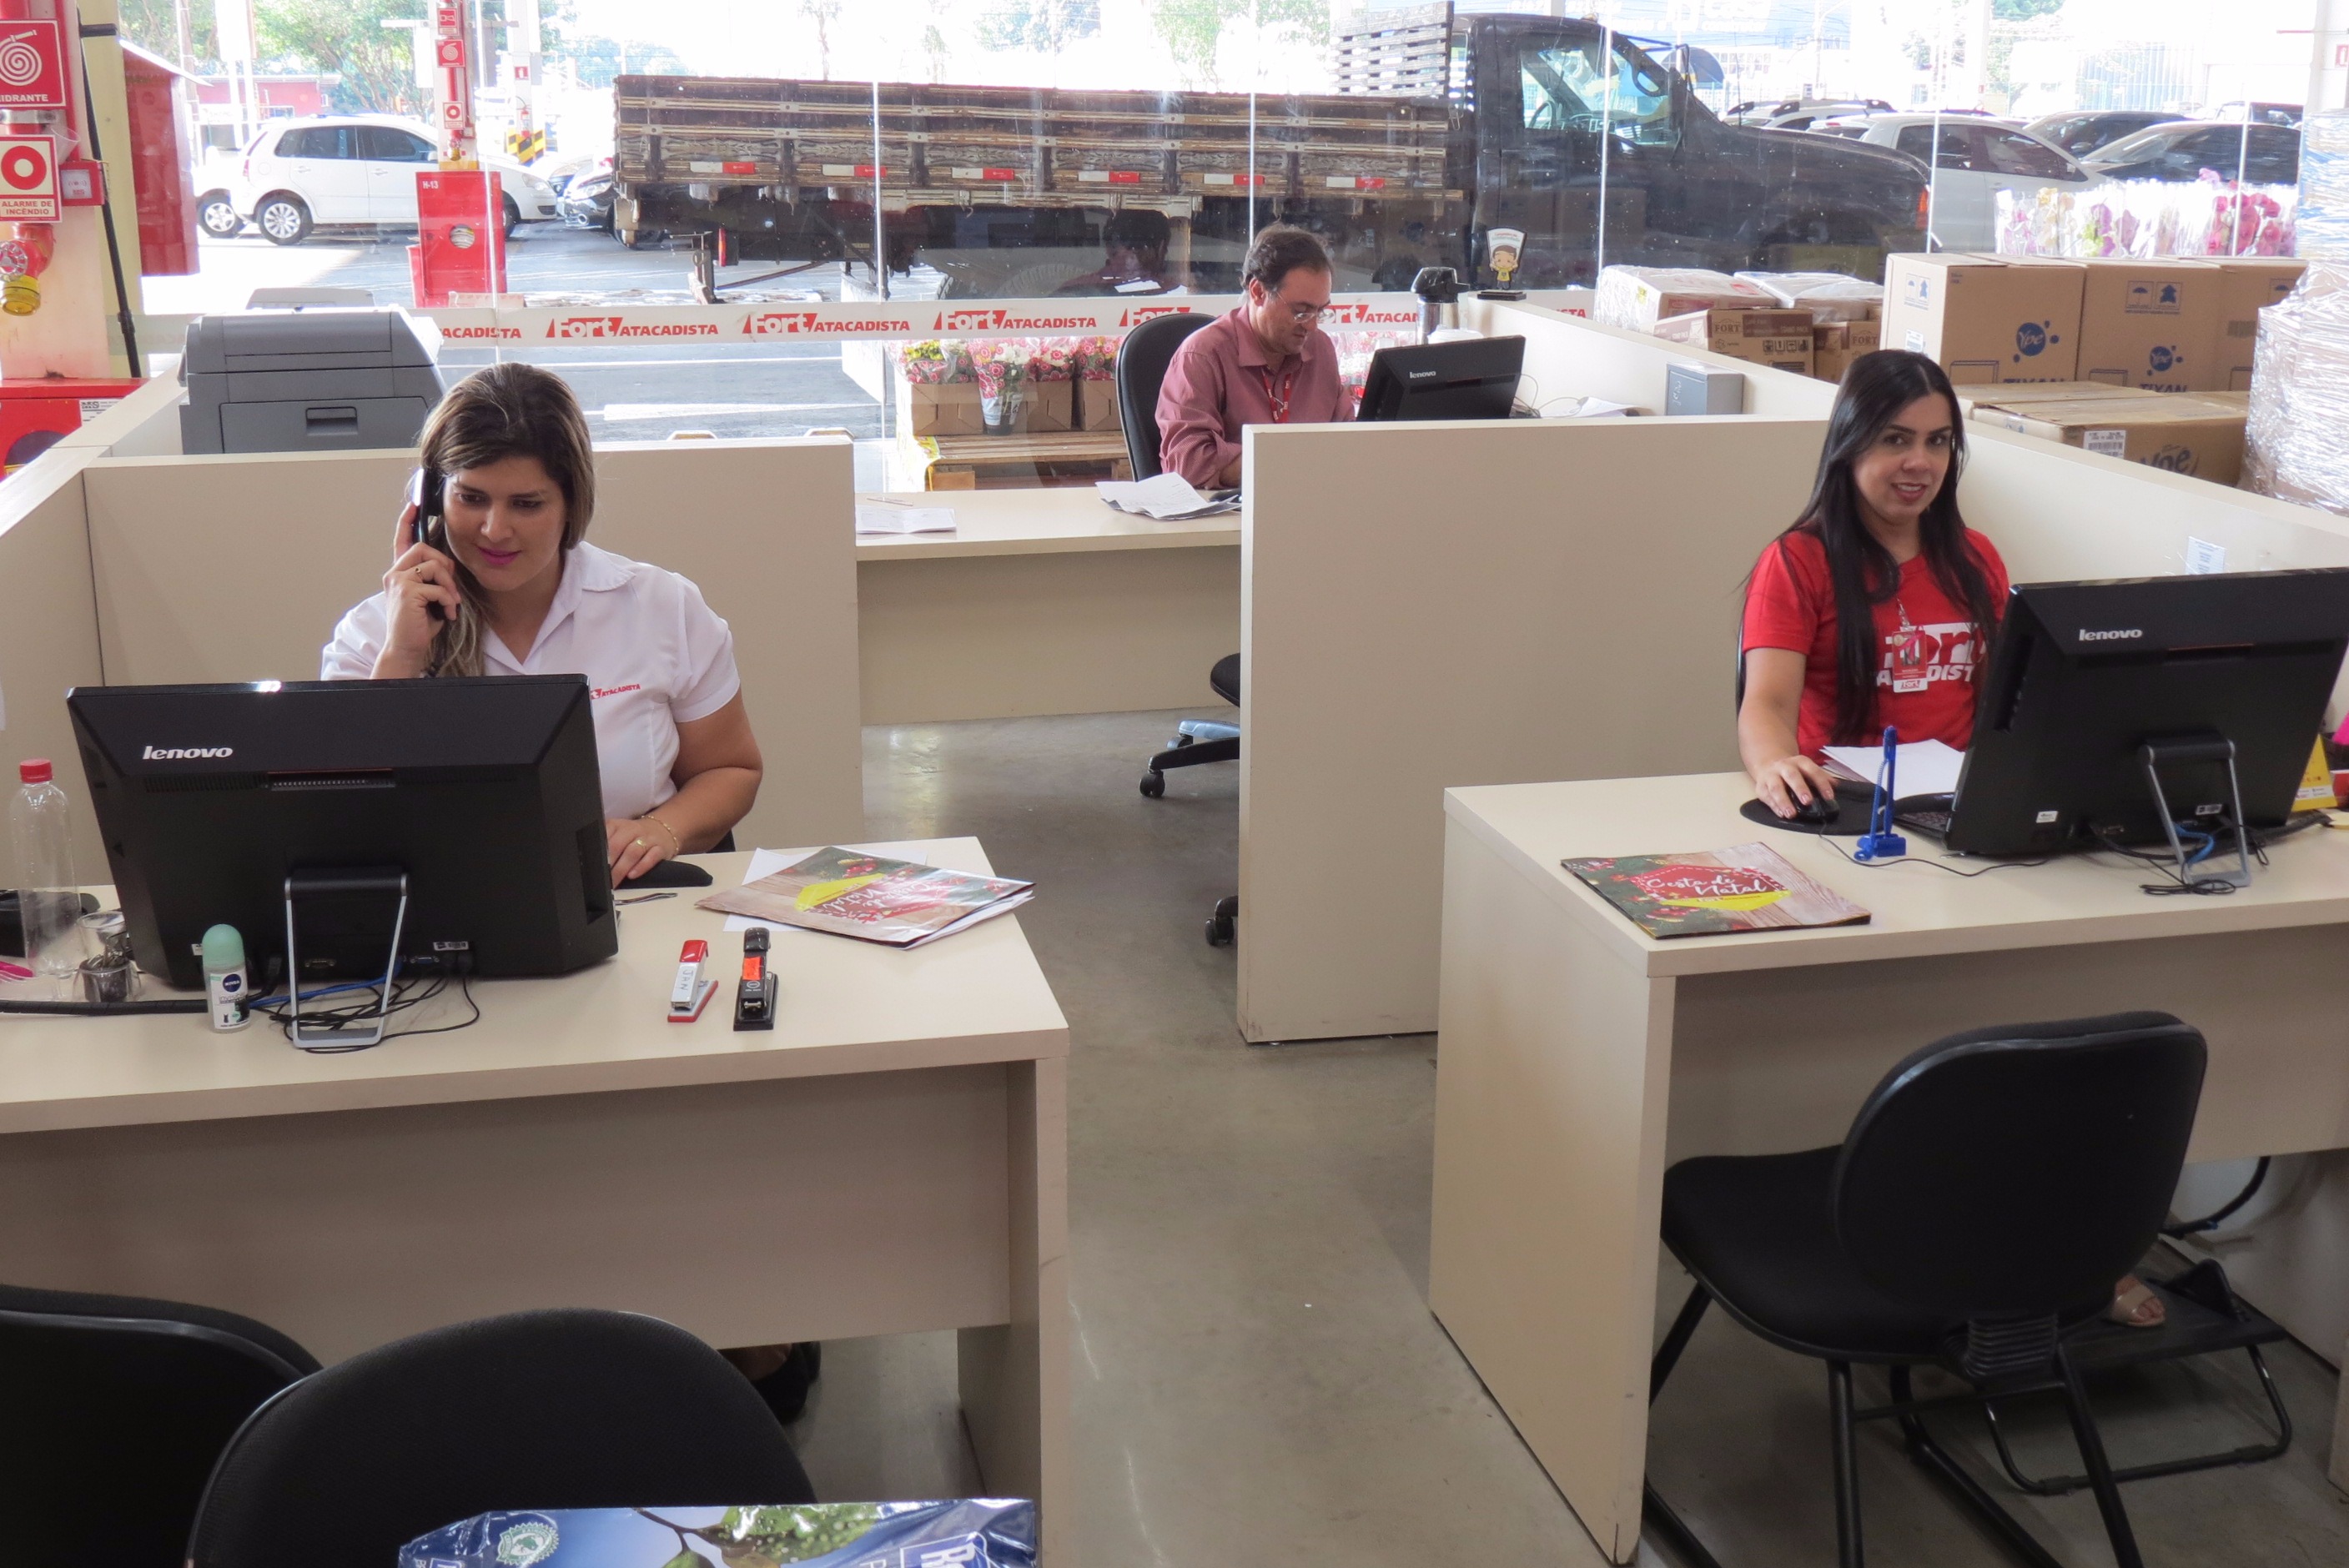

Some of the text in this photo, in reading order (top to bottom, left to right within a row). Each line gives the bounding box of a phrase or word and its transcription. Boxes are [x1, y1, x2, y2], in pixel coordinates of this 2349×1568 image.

[0, 93, 49, 103] IDRANTE
[749, 313, 911, 334] Fort ATACADISTA
[939, 309, 1098, 330] Fort ATACADISTA
[440, 327, 521, 339] ACADISTA
[552, 317, 719, 337] Fort ATACADISTA
[1714, 324, 1741, 334] FORT
[1409, 371, 1436, 379] lenovo
[2079, 629, 2143, 641] lenovo
[601, 684, 641, 698] ATACADISTA
[142, 746, 234, 760] lenovo
[1646, 874, 1735, 888] Cesta de
[1694, 879, 1767, 896] Natal
